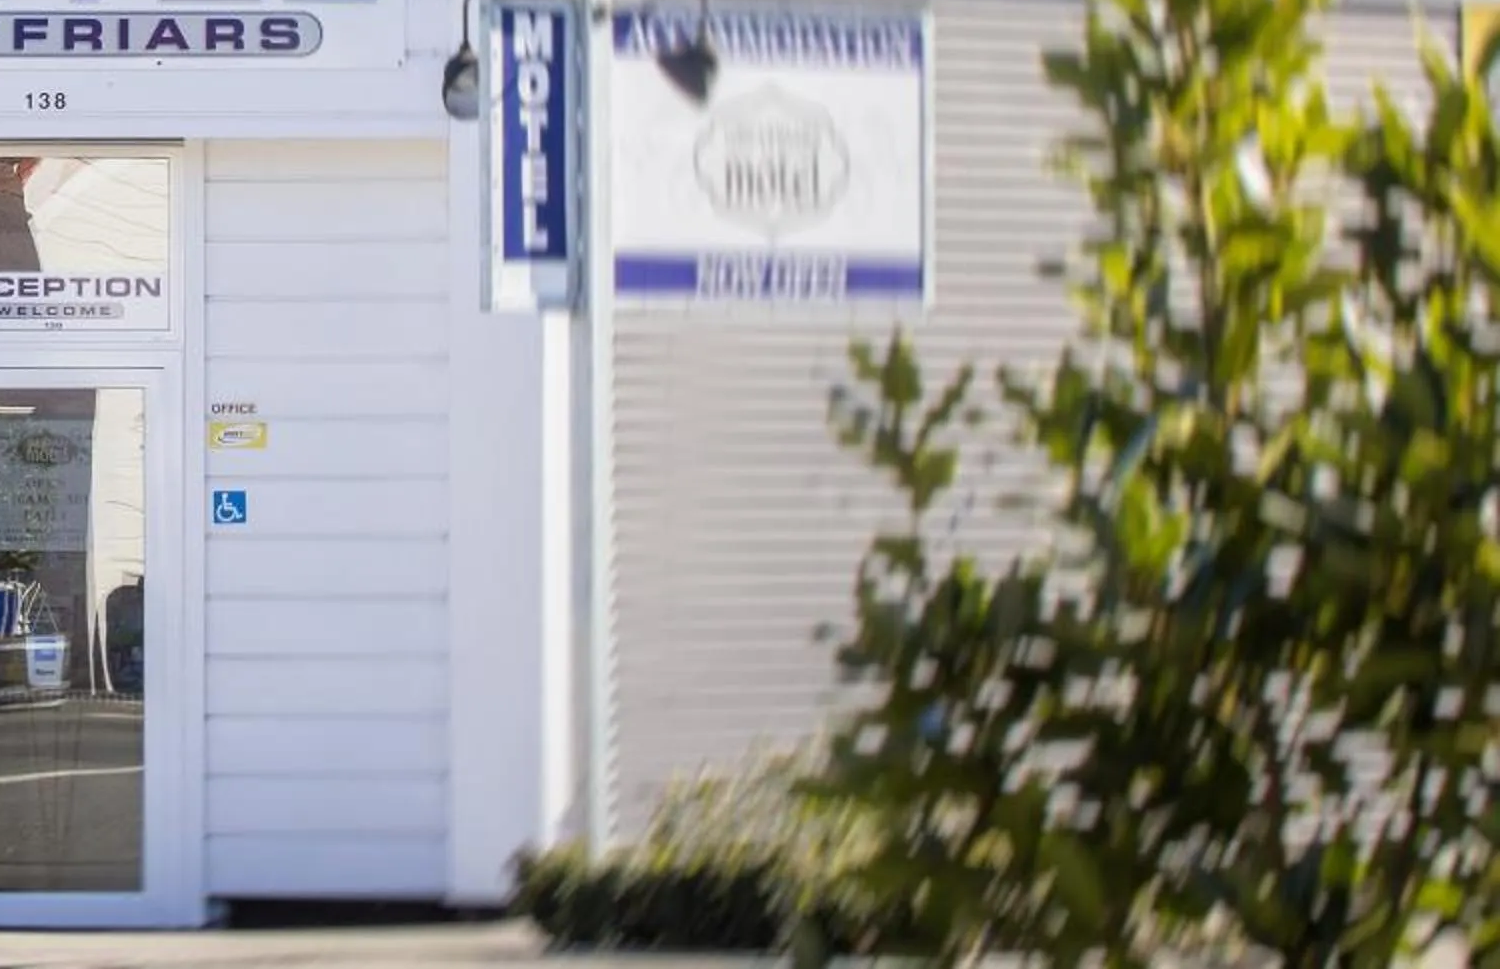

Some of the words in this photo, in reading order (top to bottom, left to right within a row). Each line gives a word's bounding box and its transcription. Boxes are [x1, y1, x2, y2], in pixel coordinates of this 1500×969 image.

[25, 92, 67, 110] 138
[512, 9, 553, 252] MOTEL
[211, 403, 258, 415] OFFICE
